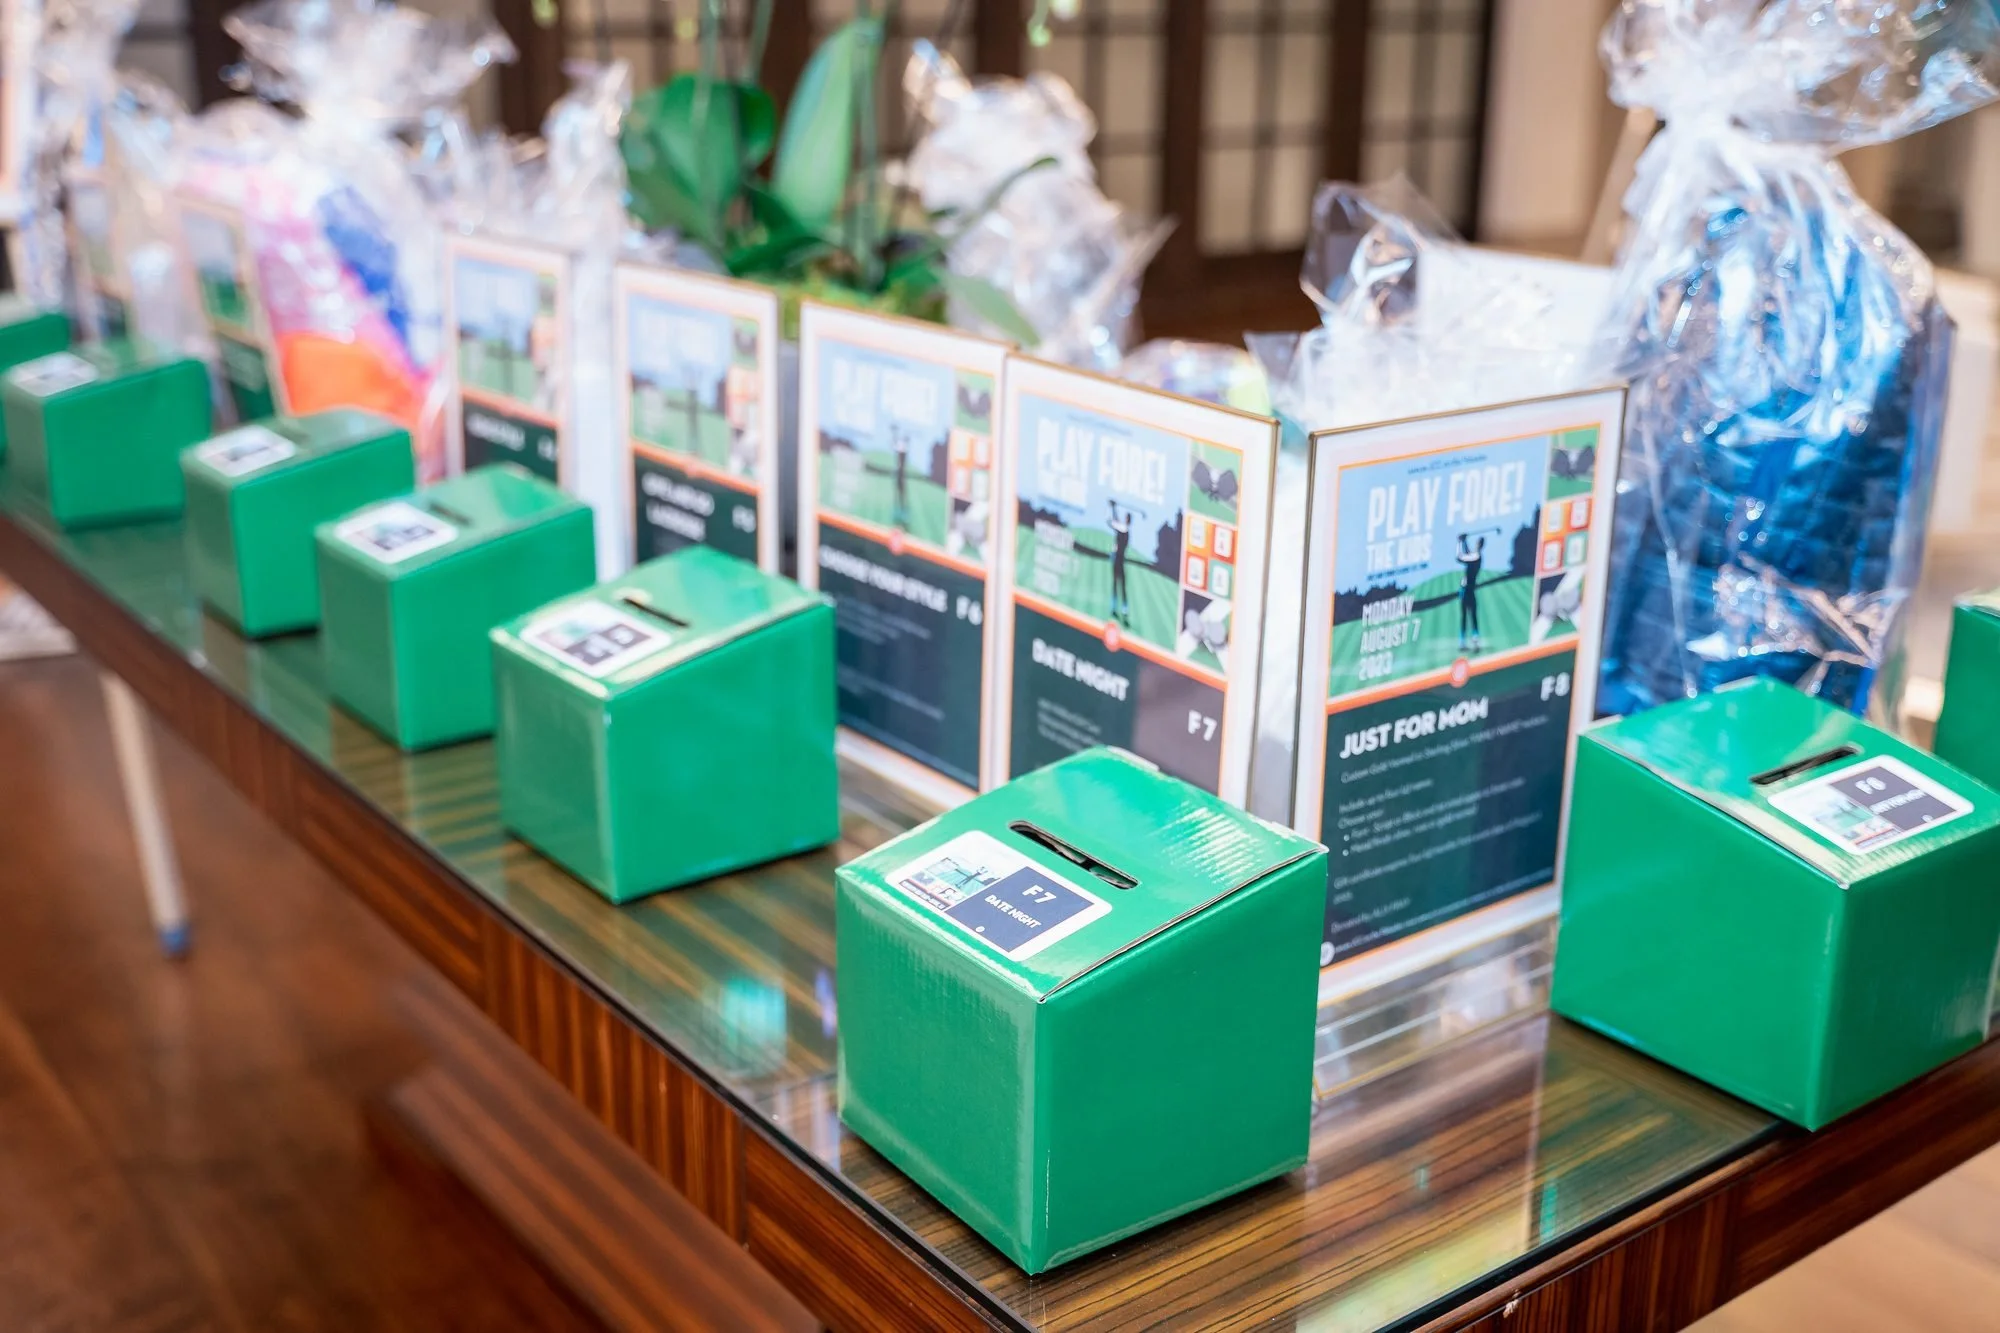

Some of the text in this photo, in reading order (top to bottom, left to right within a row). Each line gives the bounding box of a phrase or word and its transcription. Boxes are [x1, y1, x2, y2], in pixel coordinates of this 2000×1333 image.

[1367, 461, 1526, 542] PLAY FORE!
[1366, 539, 1396, 572] THE
[1362, 593, 1415, 628] MONDAY
[1360, 618, 1421, 654] AUGUST 7
[1032, 637, 1130, 701] DATE NIGHT
[1359, 651, 1393, 681] 2023
[1188, 708, 1217, 742] F7
[1339, 722, 1392, 759] JUST
[1393, 710, 1437, 744] FOR
[1437, 696, 1489, 731] MOM
[984, 894, 1042, 929] DATE NIGHT
[1022, 884, 1057, 904] F7
